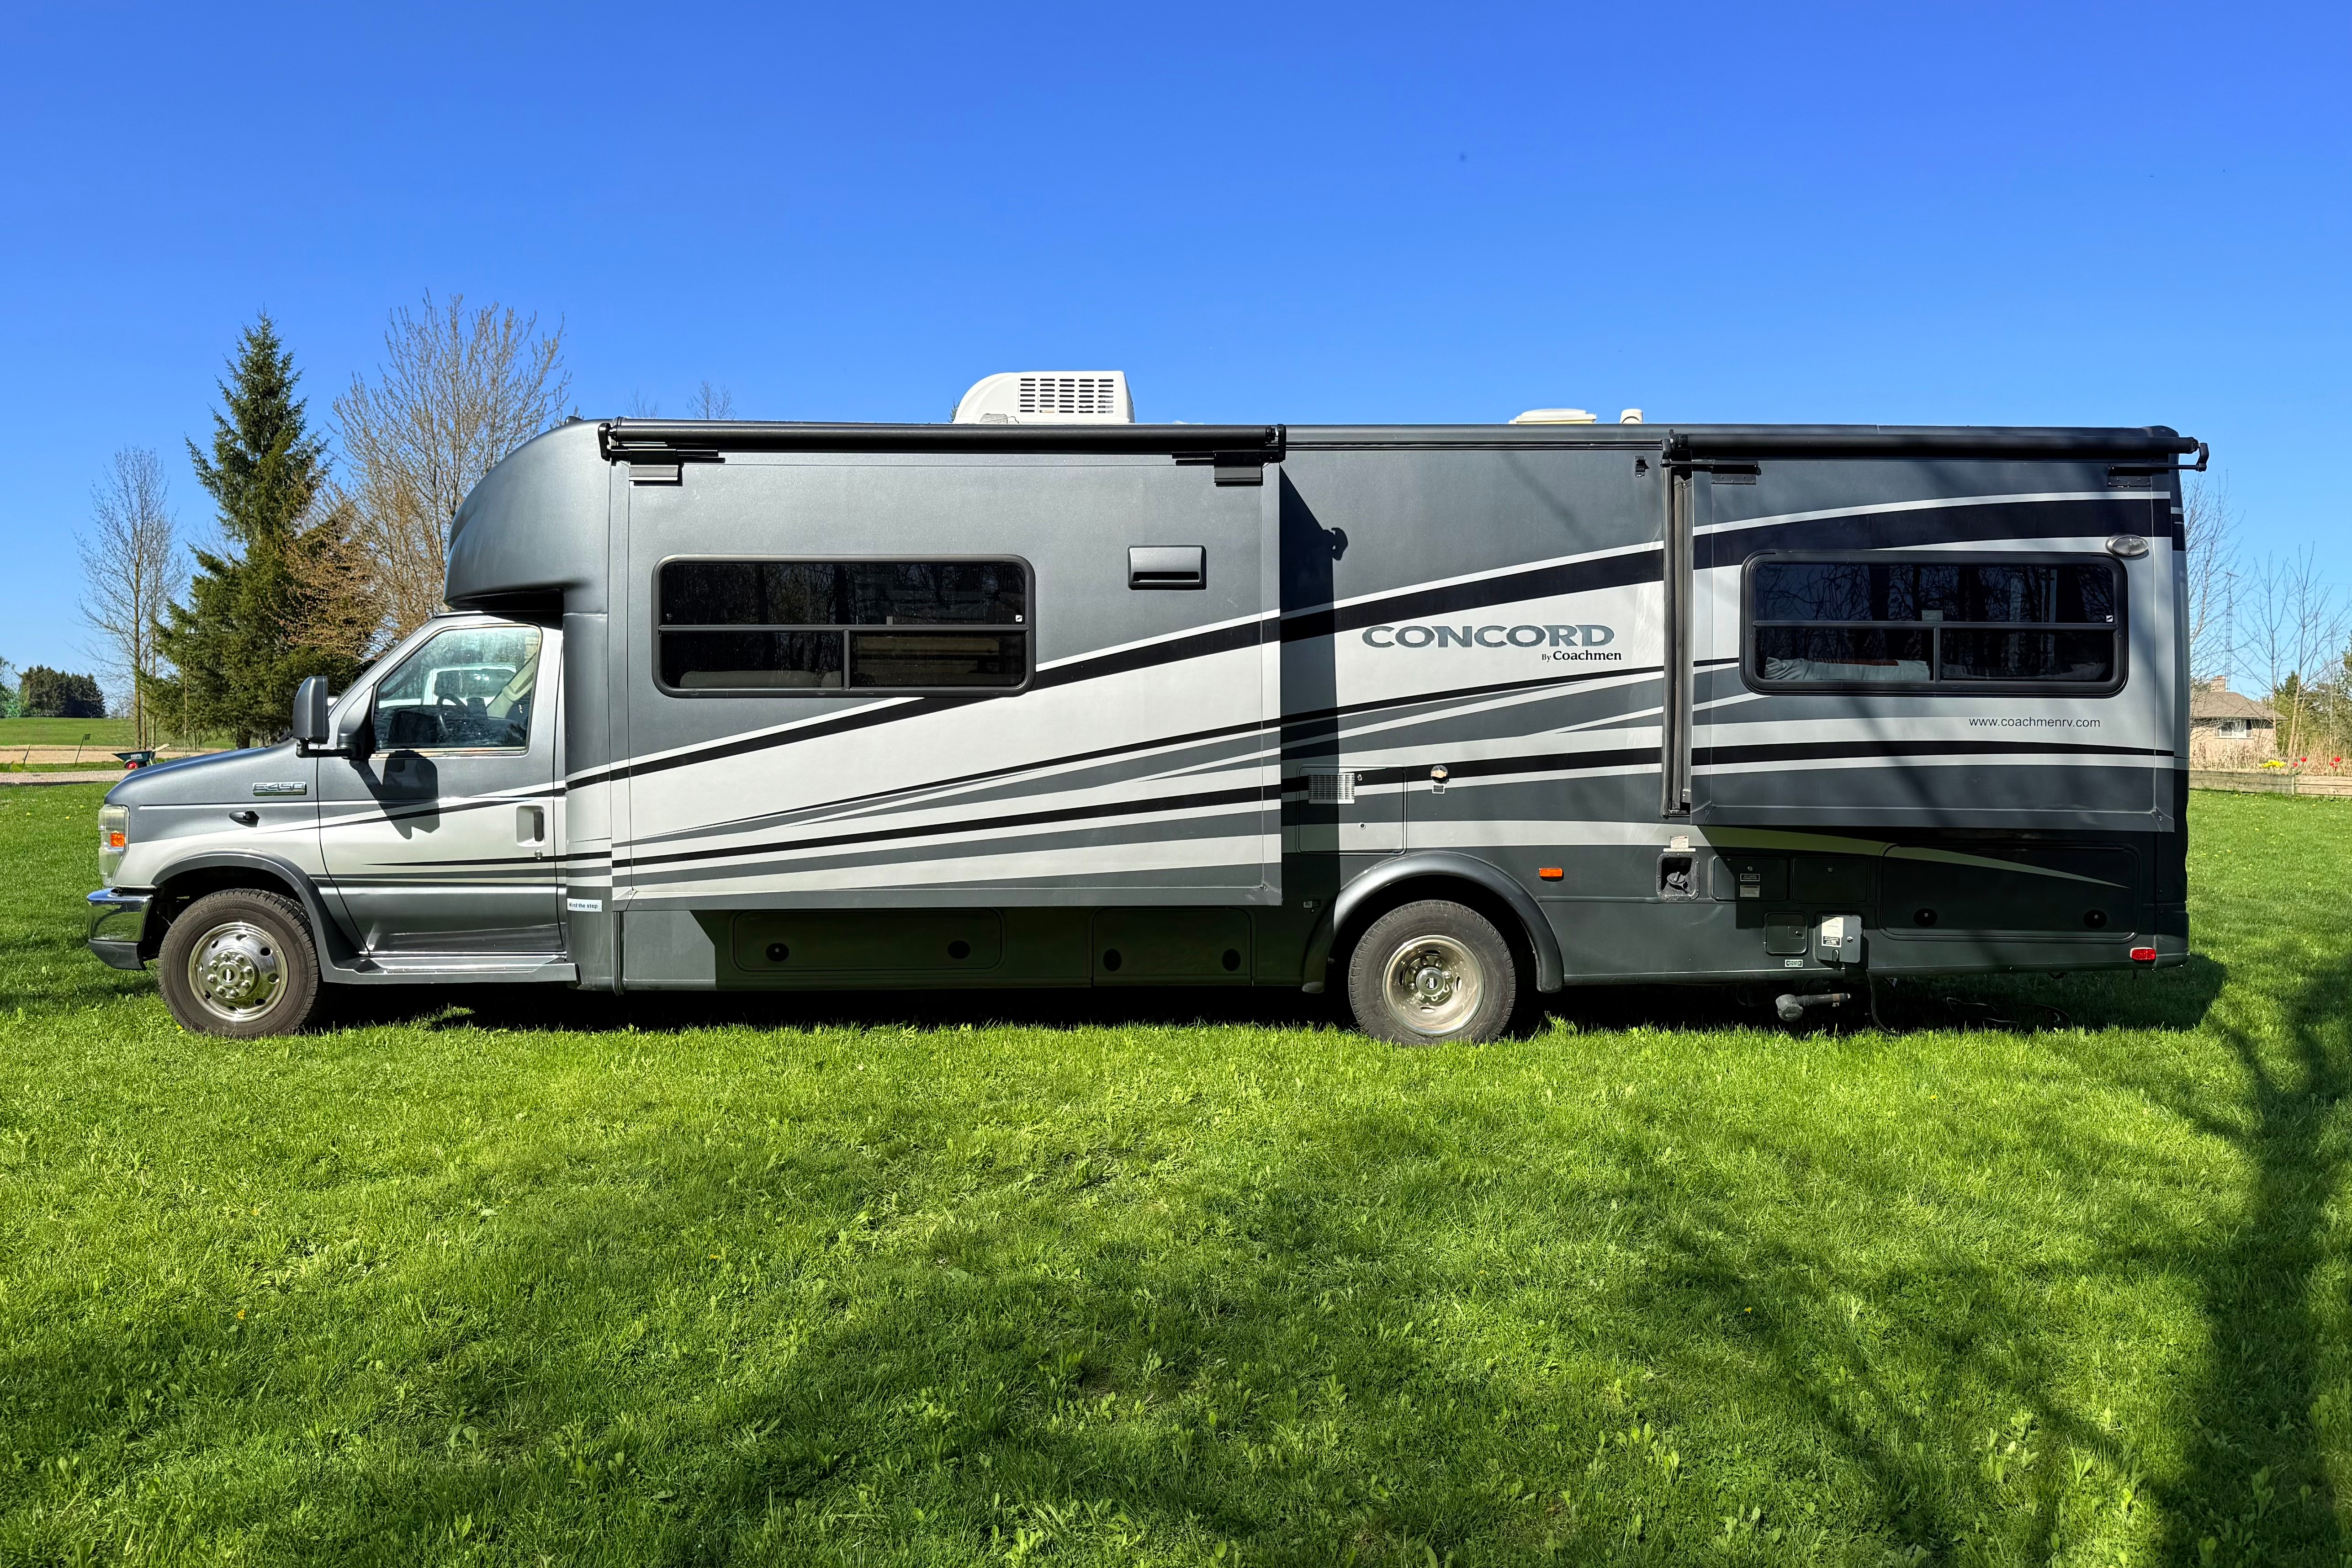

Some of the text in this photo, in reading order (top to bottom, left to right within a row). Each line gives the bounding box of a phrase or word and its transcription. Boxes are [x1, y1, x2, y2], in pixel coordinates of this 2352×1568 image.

[1362, 625, 1615, 648] CONCORD
[1542, 650, 1621, 662] By Coachmen
[1969, 716, 2100, 727] www.coachmenrv.com
